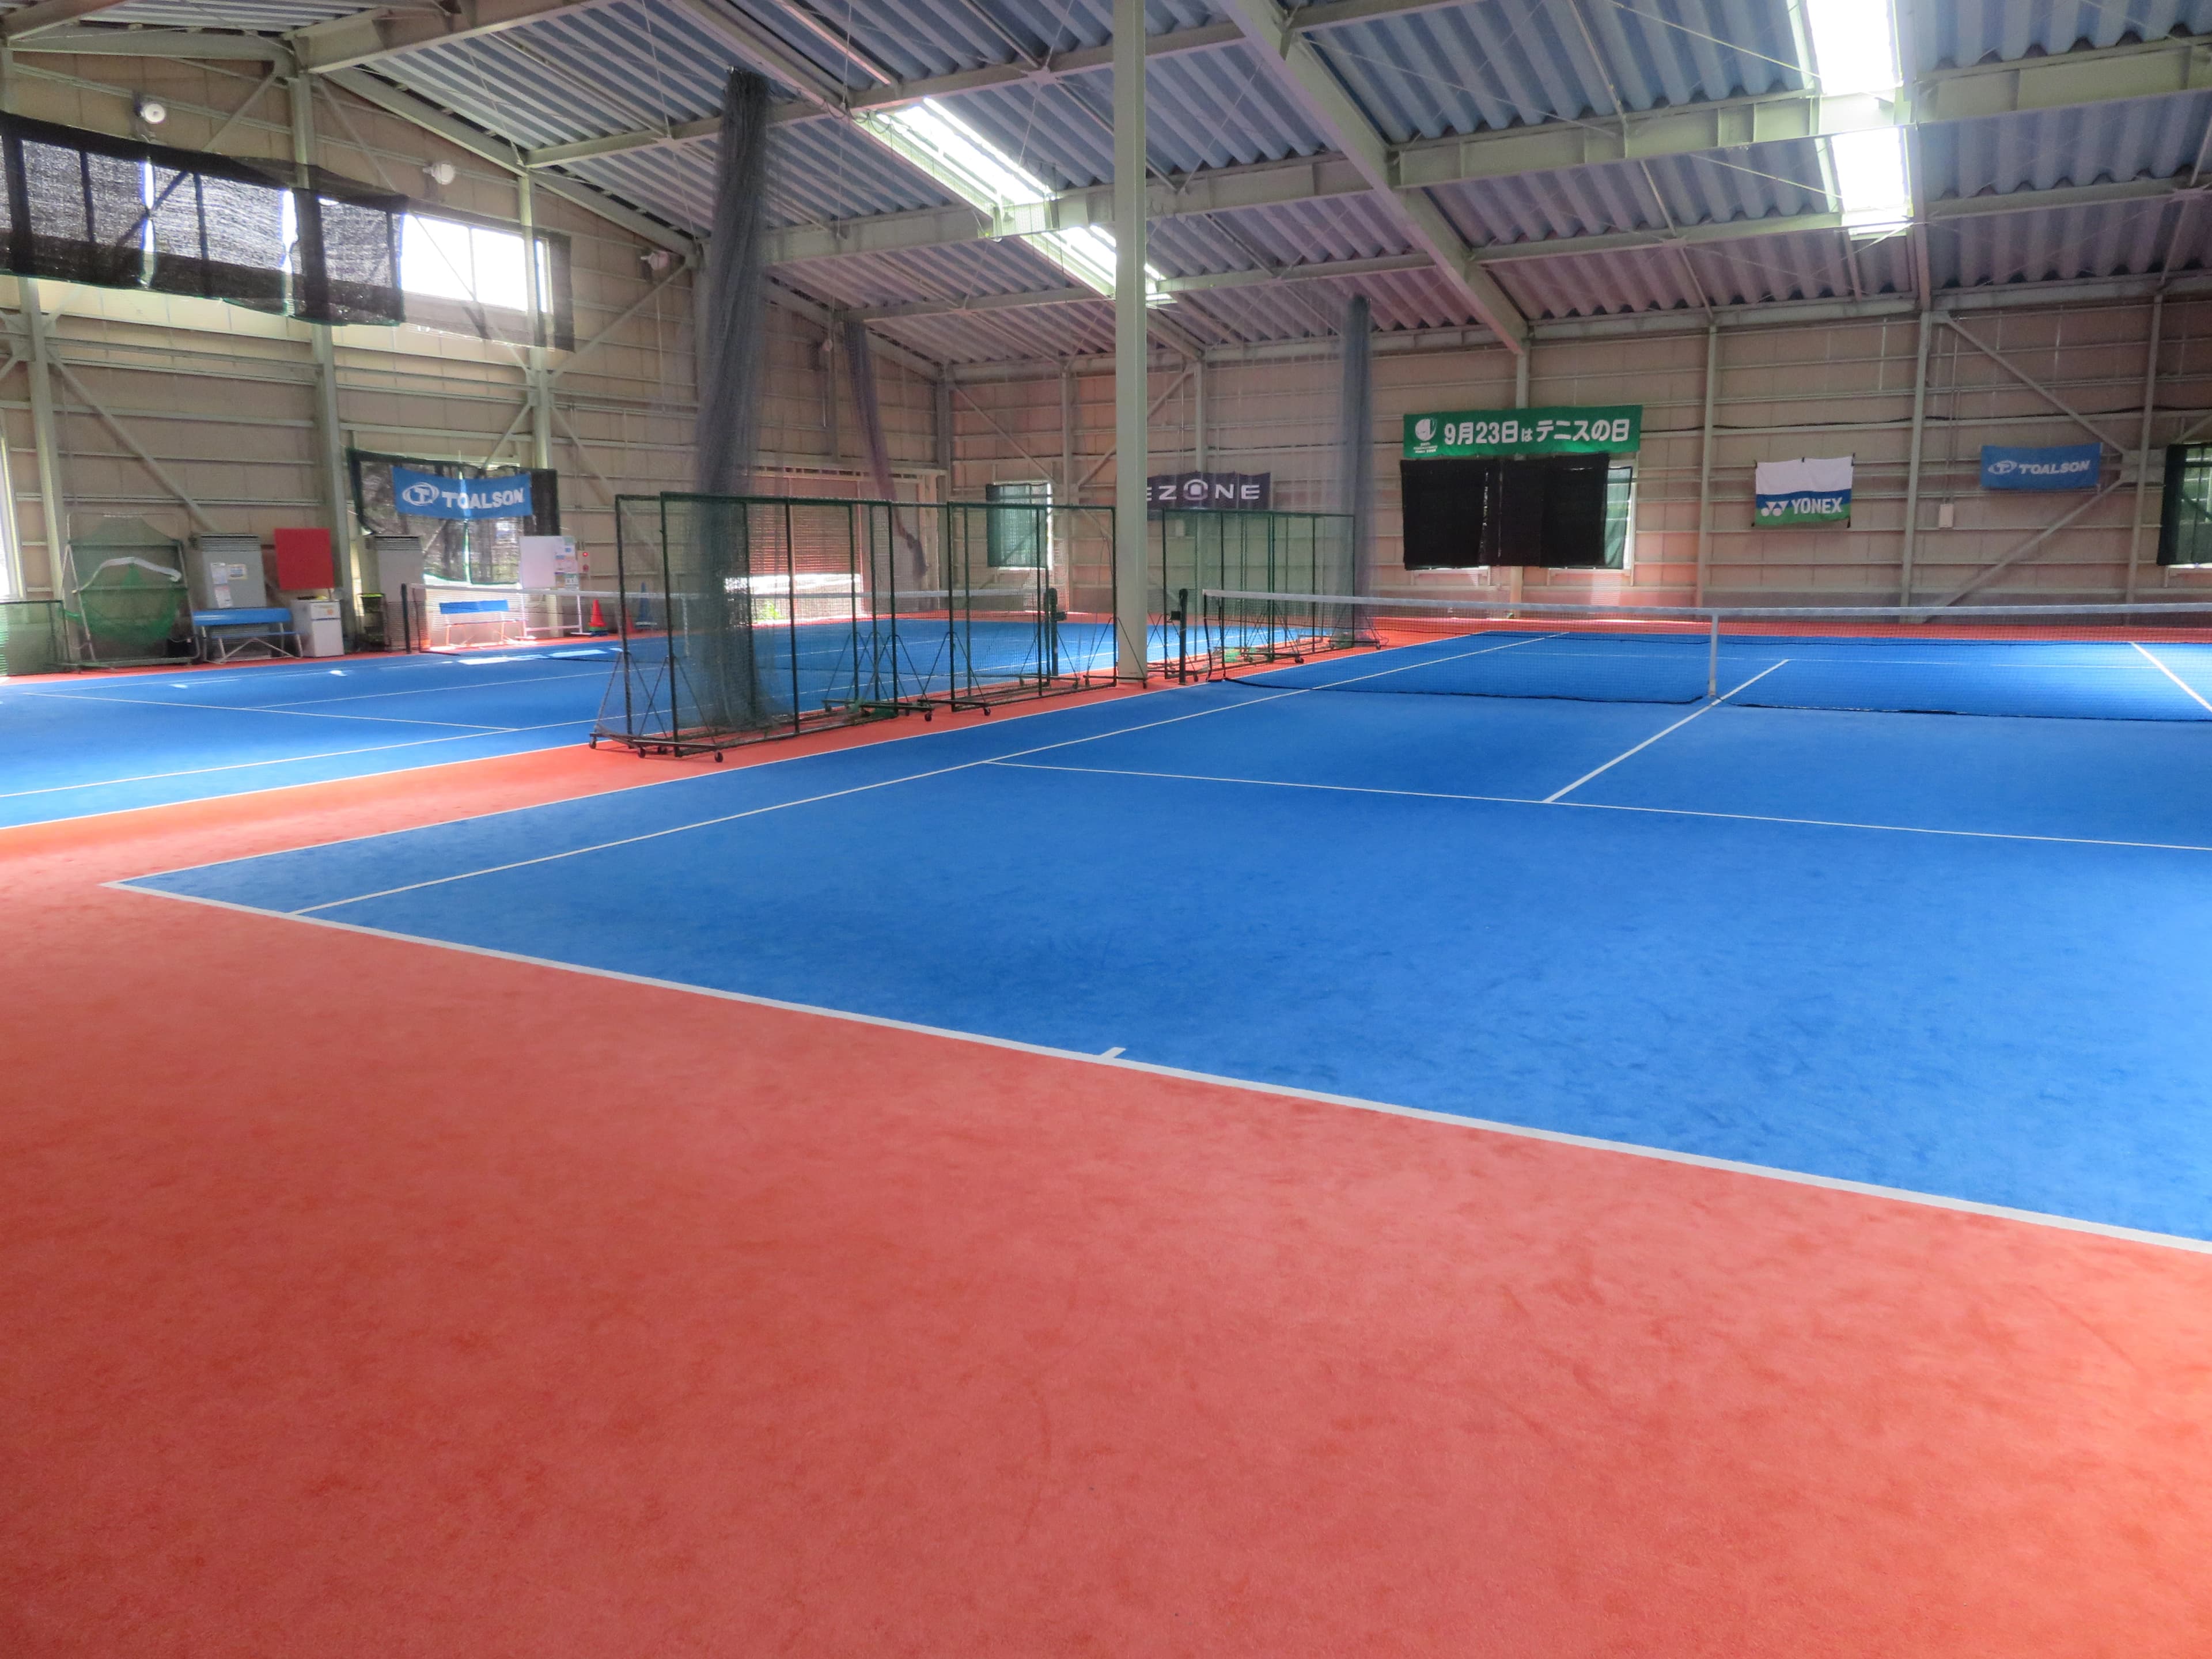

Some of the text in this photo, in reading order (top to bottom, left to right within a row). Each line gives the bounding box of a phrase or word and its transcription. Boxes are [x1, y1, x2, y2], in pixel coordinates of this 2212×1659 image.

[1444, 419, 1630, 445] 9月23日はテニスの日
[2018, 460, 2091, 475] TOALSON
[441, 487, 525, 509] TOALSON
[1147, 479, 1260, 501] ZONE
[1791, 497, 1843, 514] YONEX
